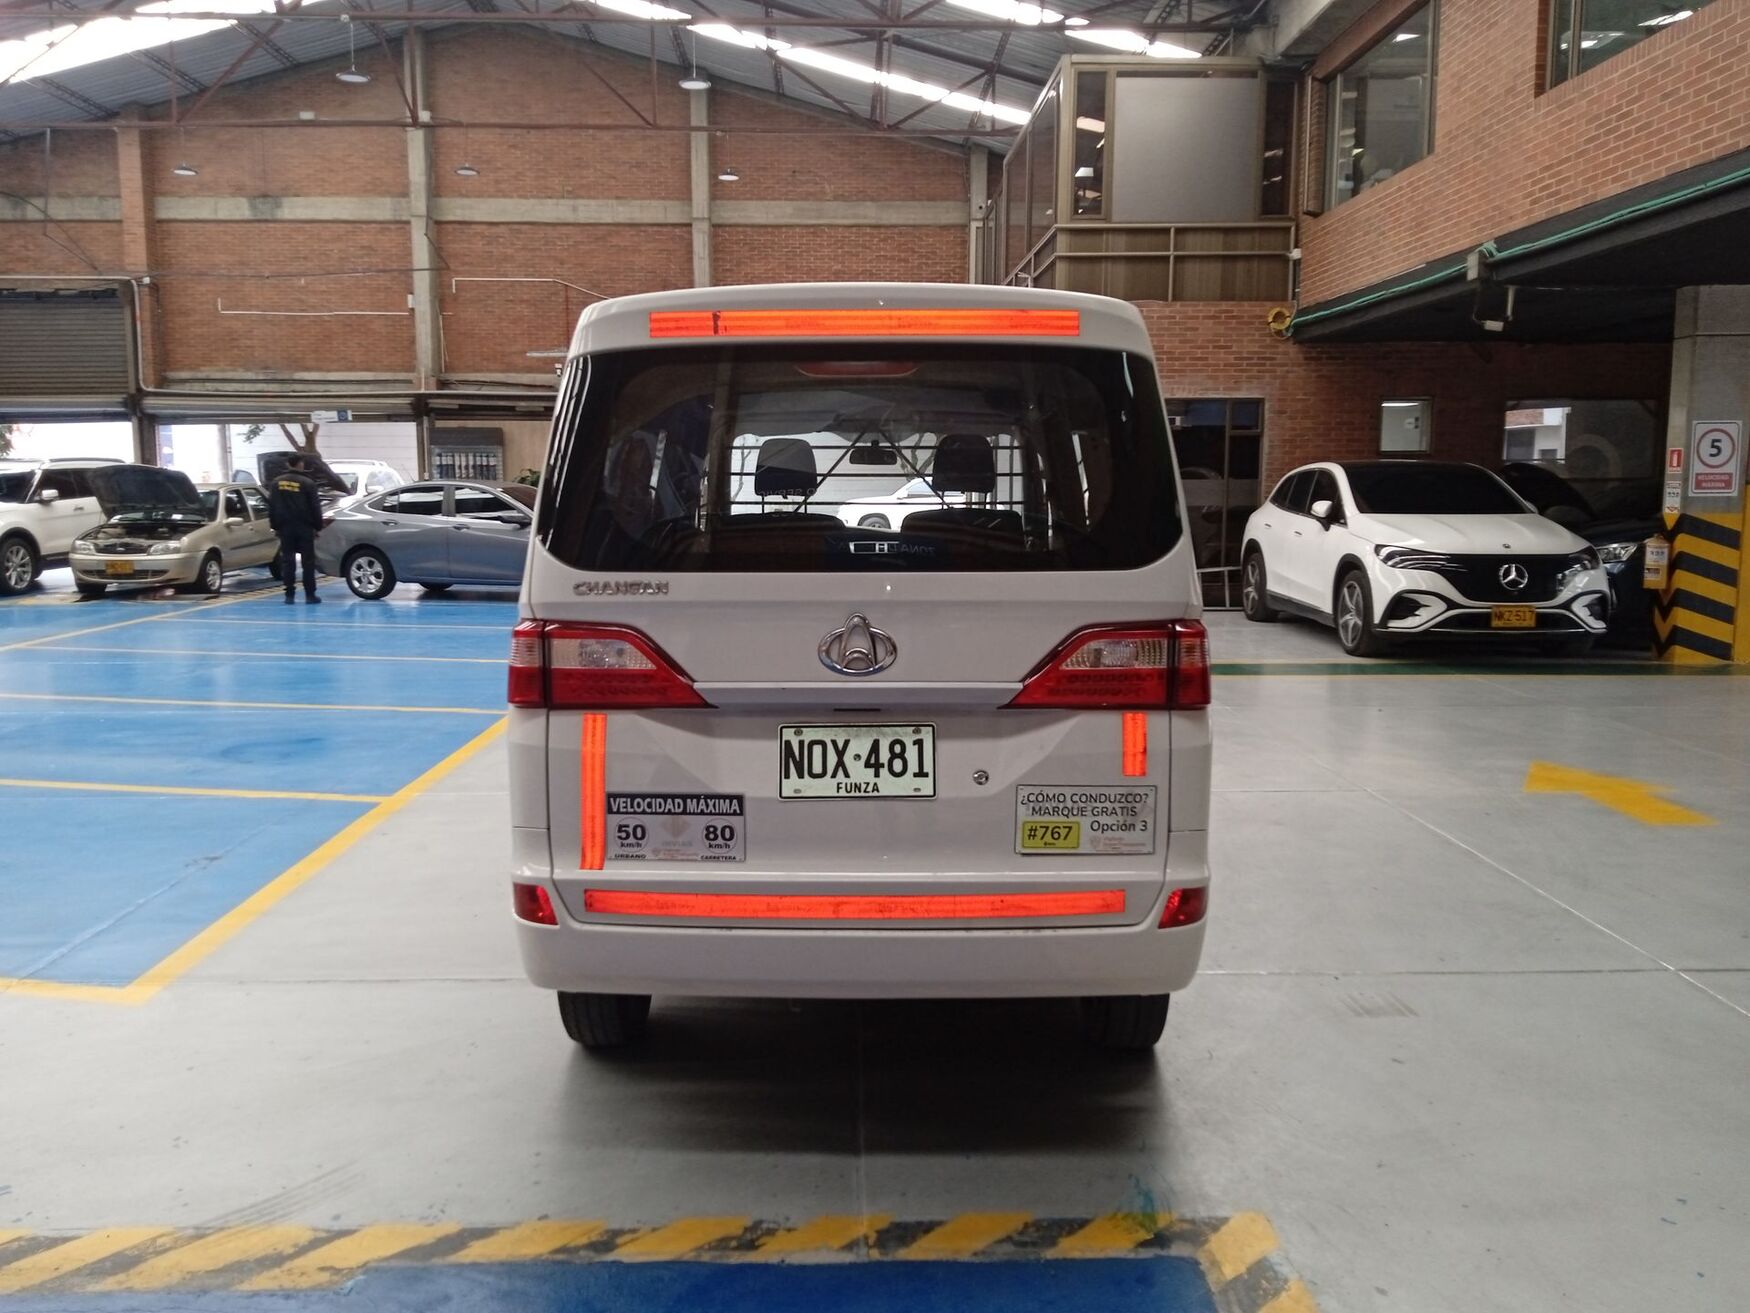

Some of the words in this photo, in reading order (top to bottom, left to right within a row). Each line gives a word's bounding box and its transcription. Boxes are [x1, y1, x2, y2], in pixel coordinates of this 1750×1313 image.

[1709, 439, 1722, 457] 5
[836, 781, 880, 794] FUNZA
[610, 798, 684, 813] VELOCIDAD
[686, 795, 740, 813] MÁXIMA
[1020, 790, 1067, 806] ¿CÓMO
[1070, 793, 1149, 804] CONDUZCO?
[1031, 806, 1088, 819] MARQUE
[1091, 807, 1138, 817] GRATIS
[617, 824, 647, 841] 50
[704, 825, 735, 842] 80
[1027, 825, 1073, 840] #767
[1090, 819, 1136, 834] Opción
[1139, 820, 1148, 831] 3
